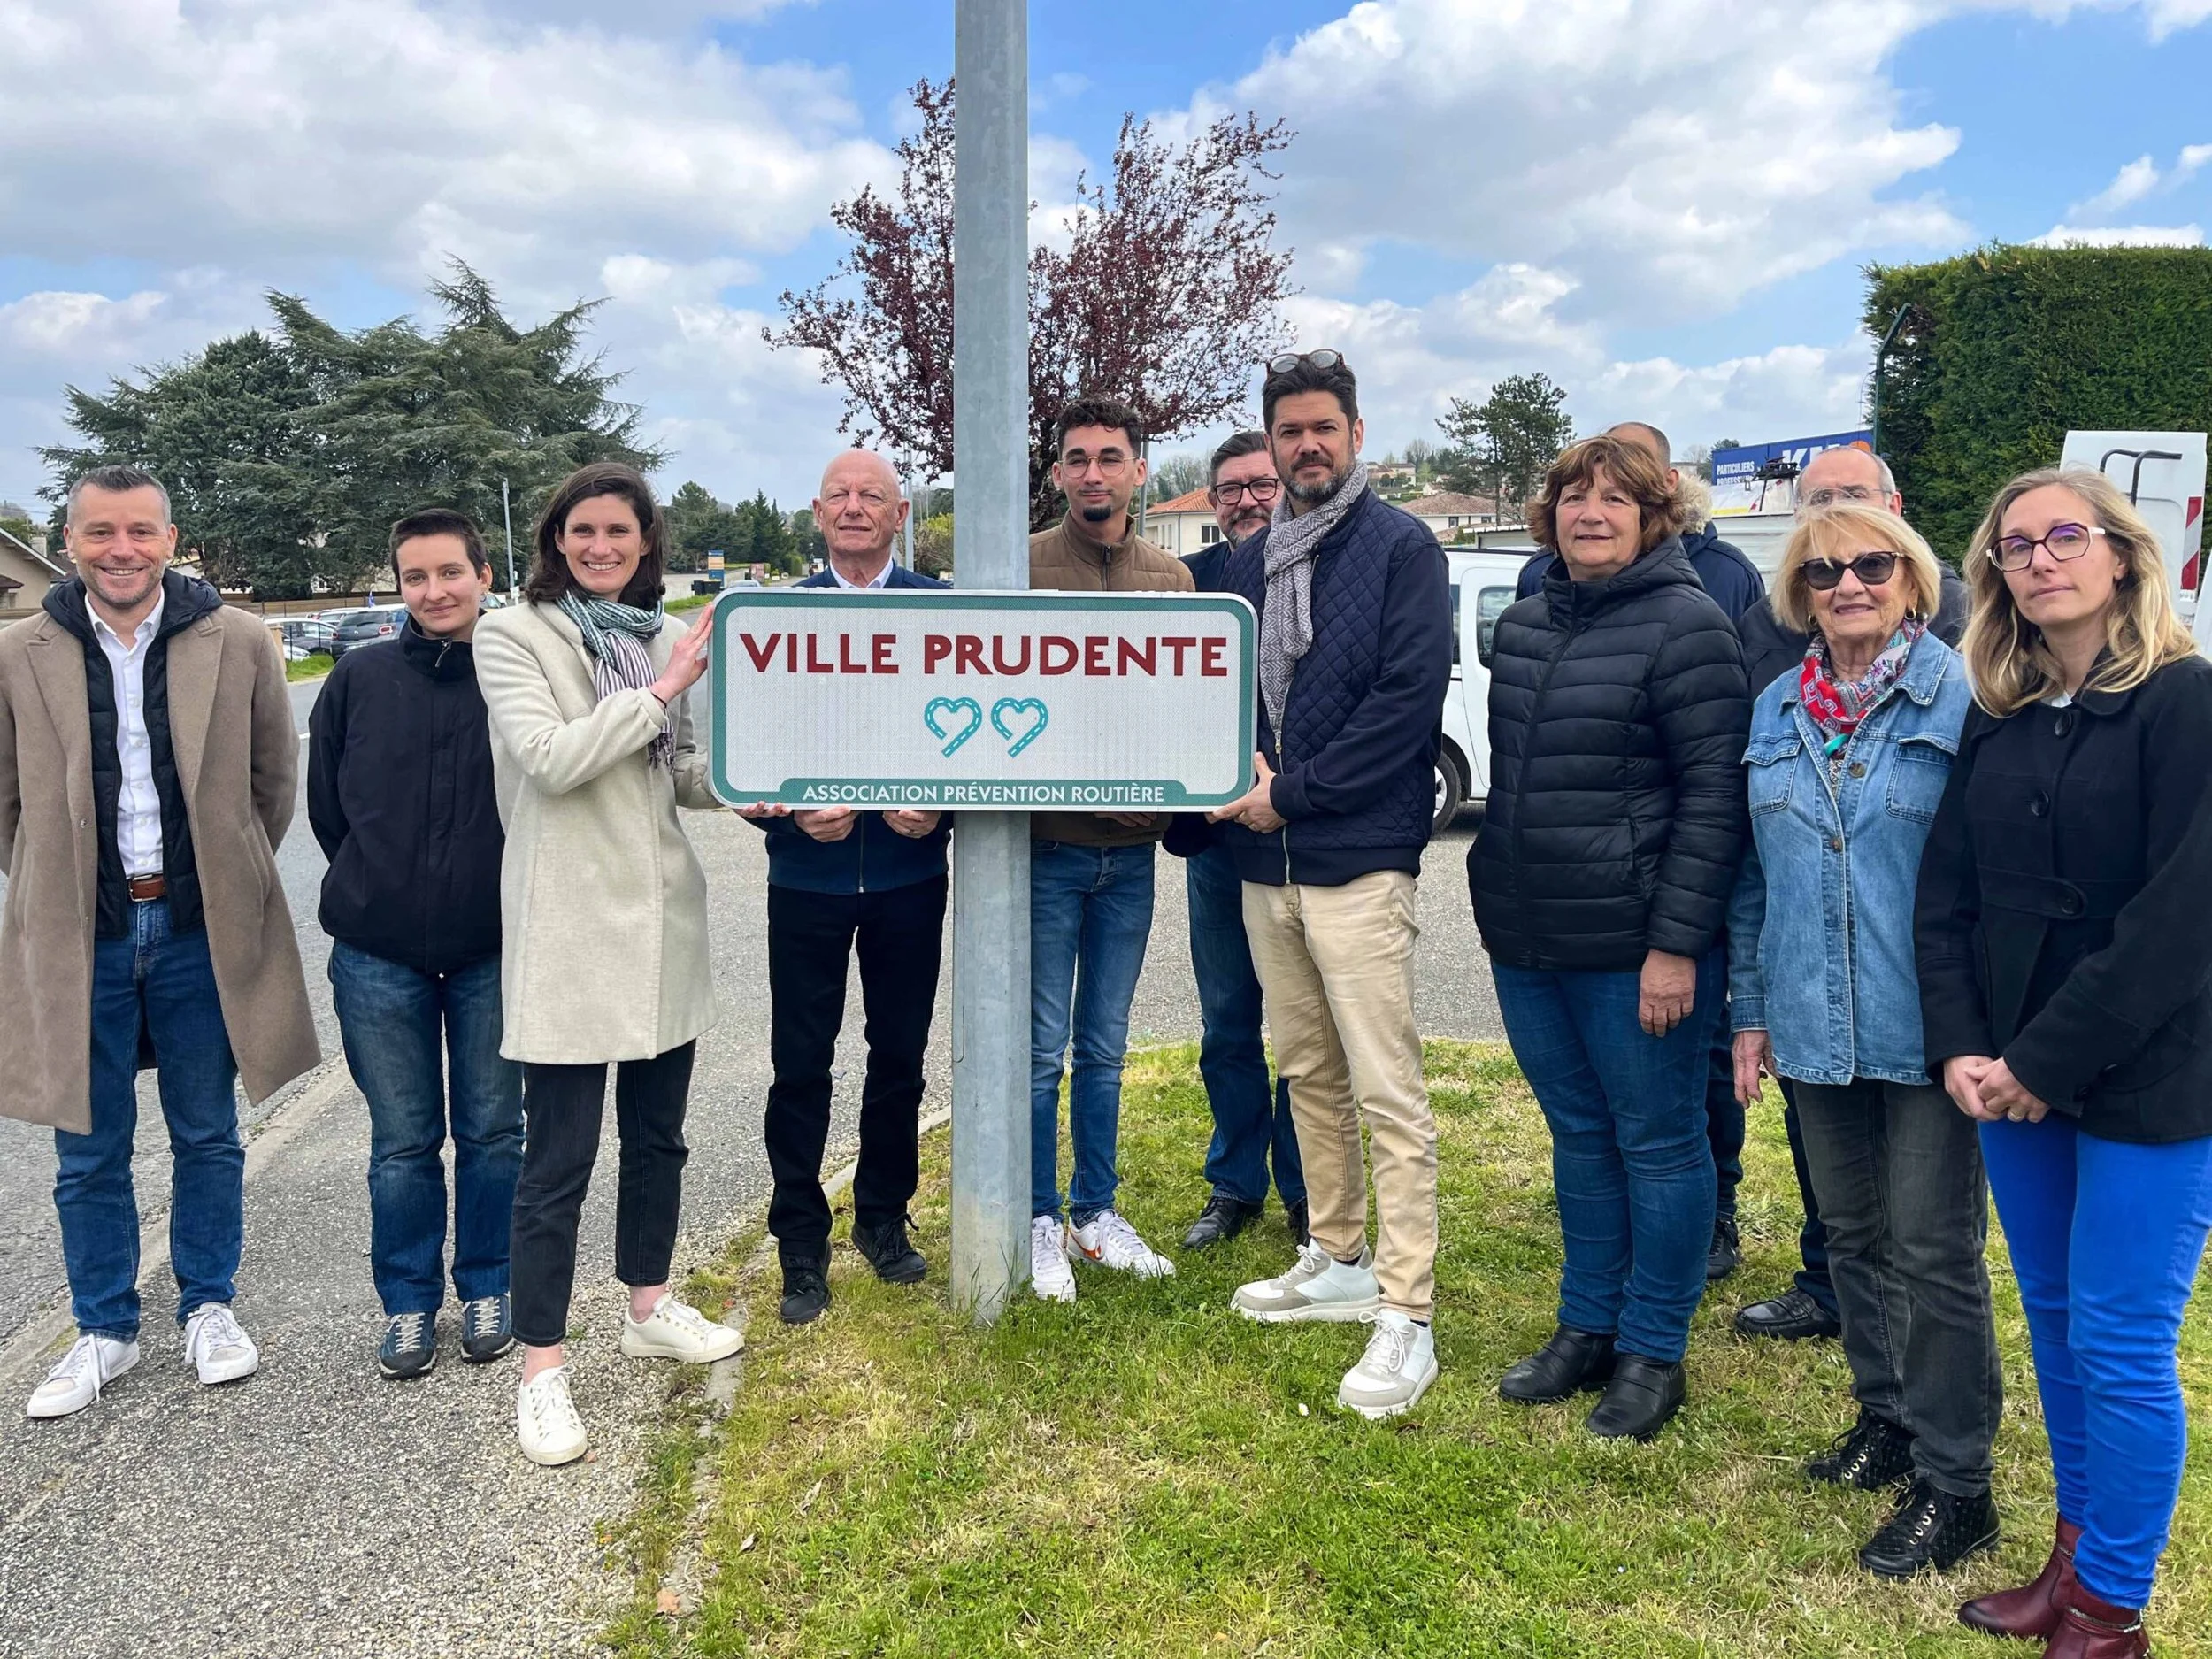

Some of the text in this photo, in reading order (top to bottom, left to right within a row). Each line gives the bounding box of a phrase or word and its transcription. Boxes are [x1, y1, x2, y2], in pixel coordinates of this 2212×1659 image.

[1717, 461, 1755, 475] PARTICULIERS
[740, 634, 1227, 676] VILLE PRUDENTE
[802, 782, 1164, 803] ASSOCIATION PRÉVENTION ROUTIÈRE
